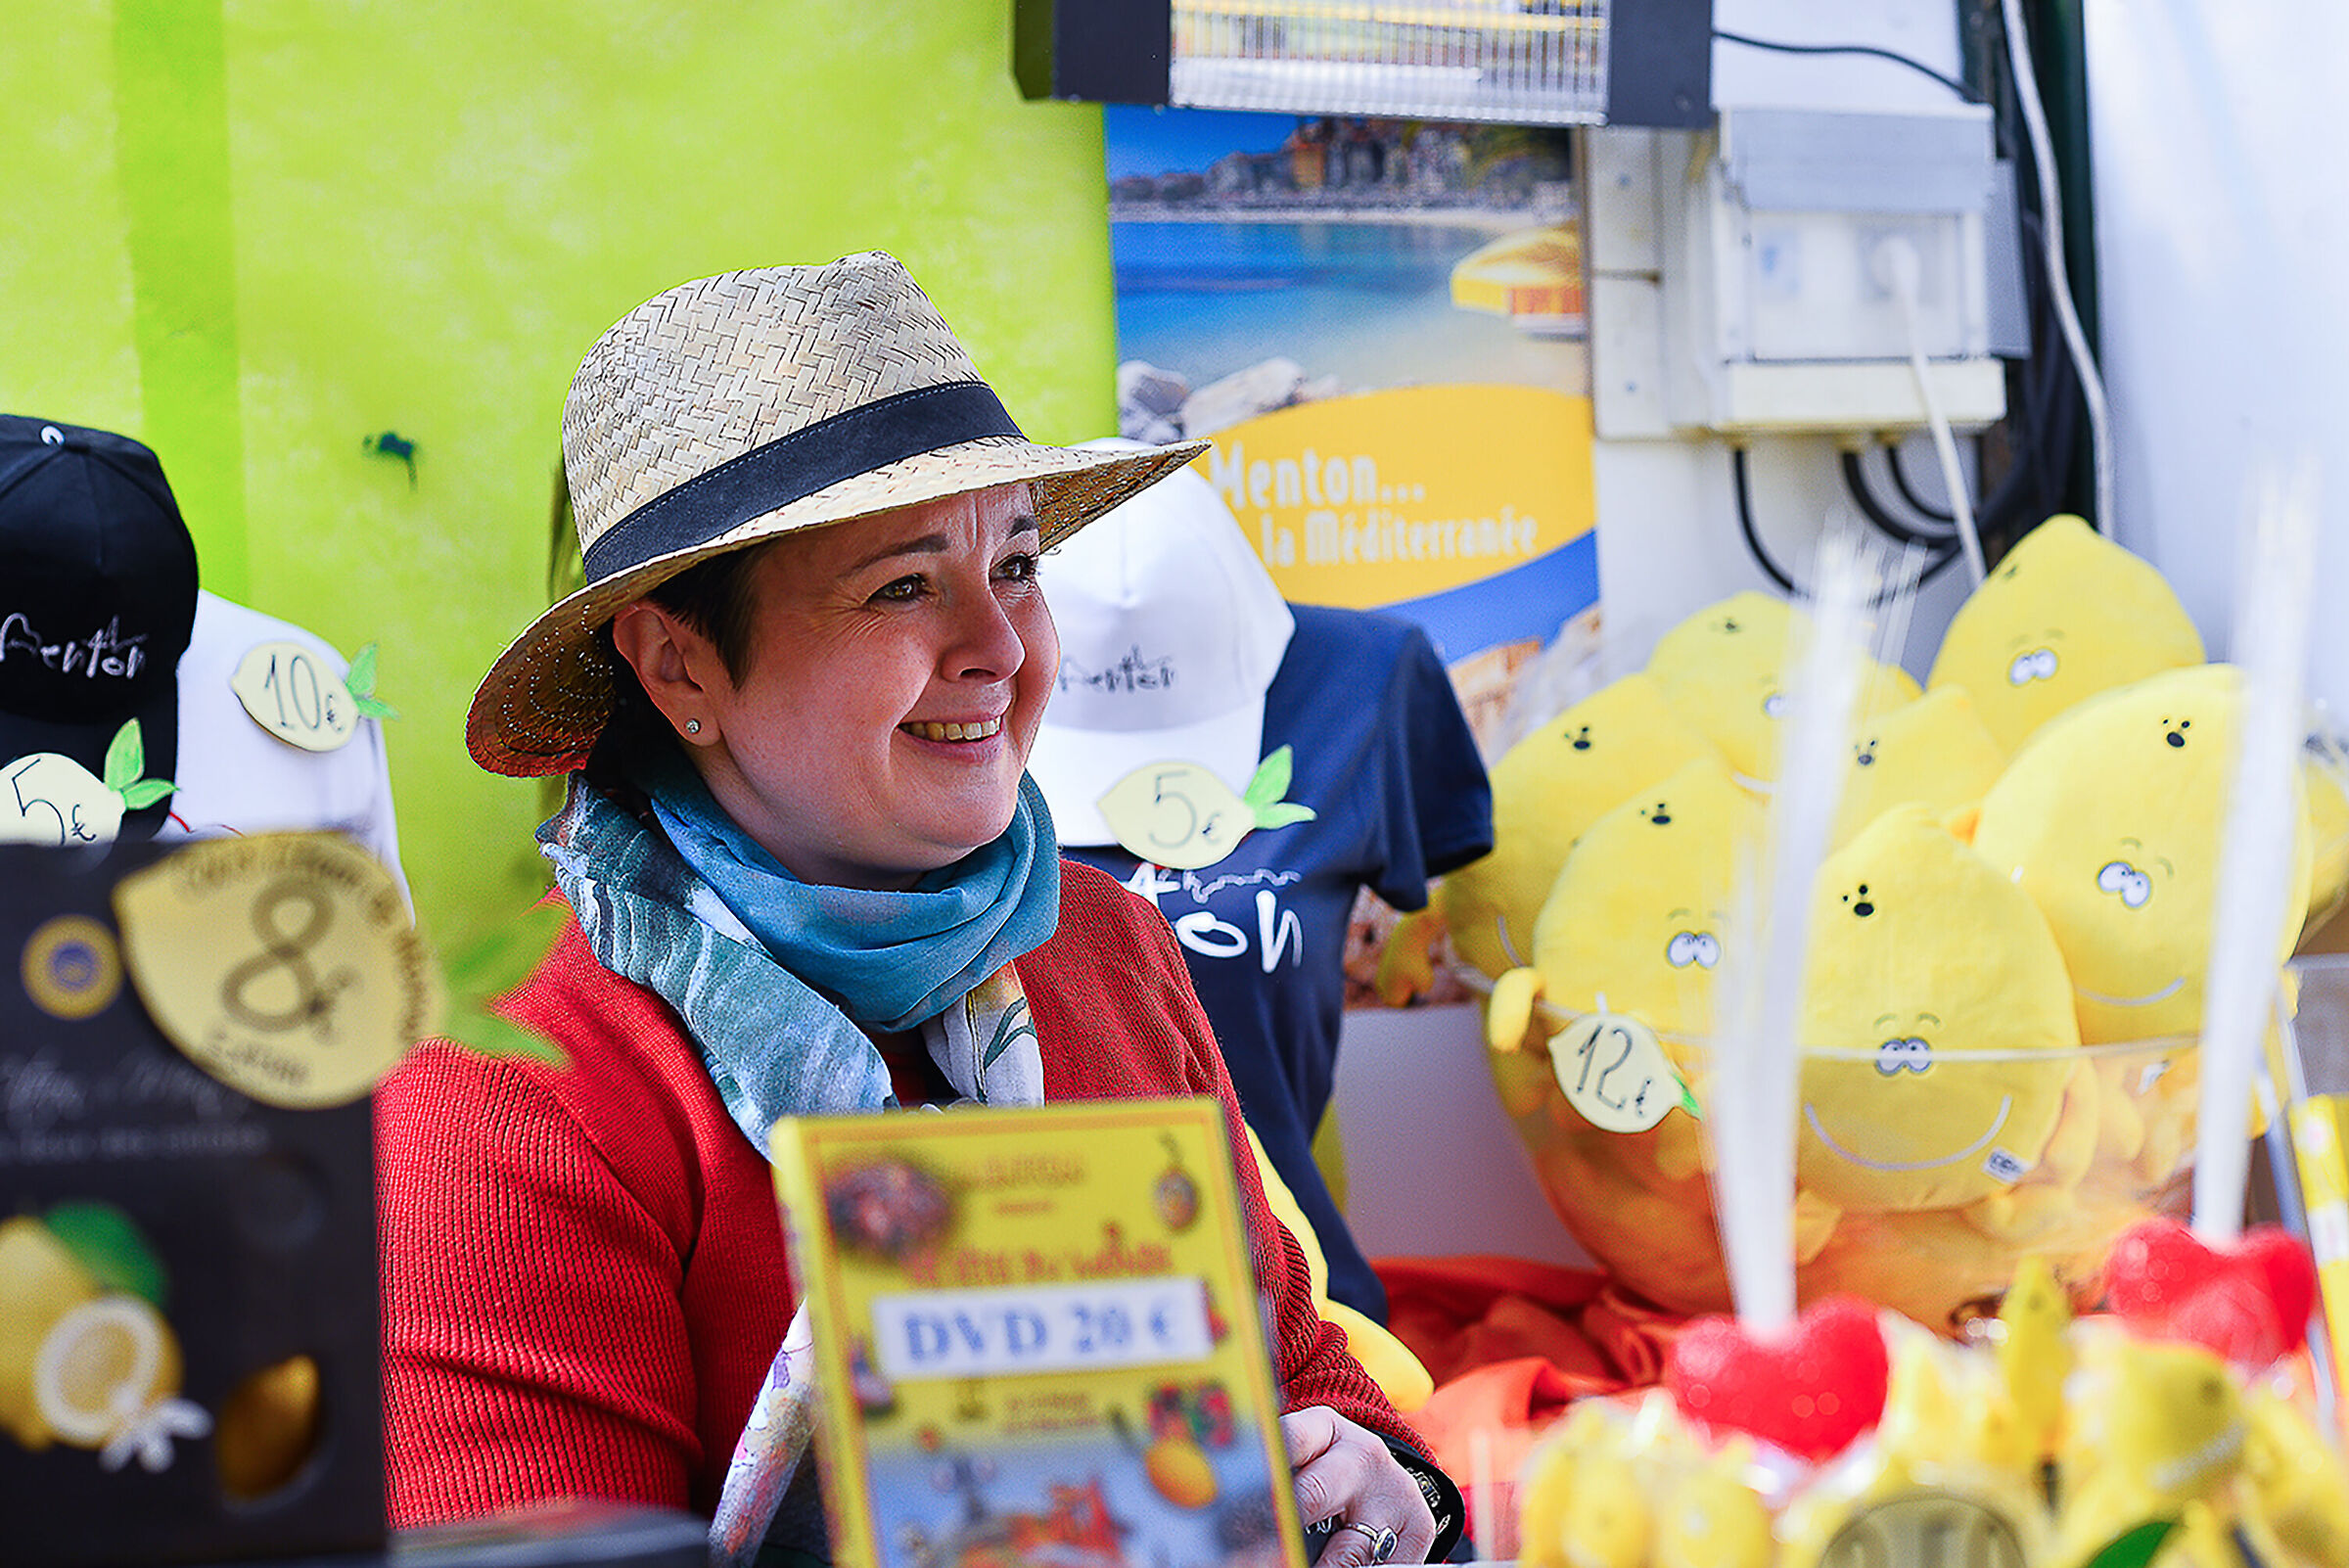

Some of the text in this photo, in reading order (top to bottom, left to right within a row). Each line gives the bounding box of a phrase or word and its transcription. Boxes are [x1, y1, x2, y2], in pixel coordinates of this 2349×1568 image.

[1208, 438, 1426, 510] Menton...
[1260, 503, 1539, 569] la Méditerranée
[901, 1309, 1048, 1362] DVD
[1069, 1302, 1132, 1355] 20
